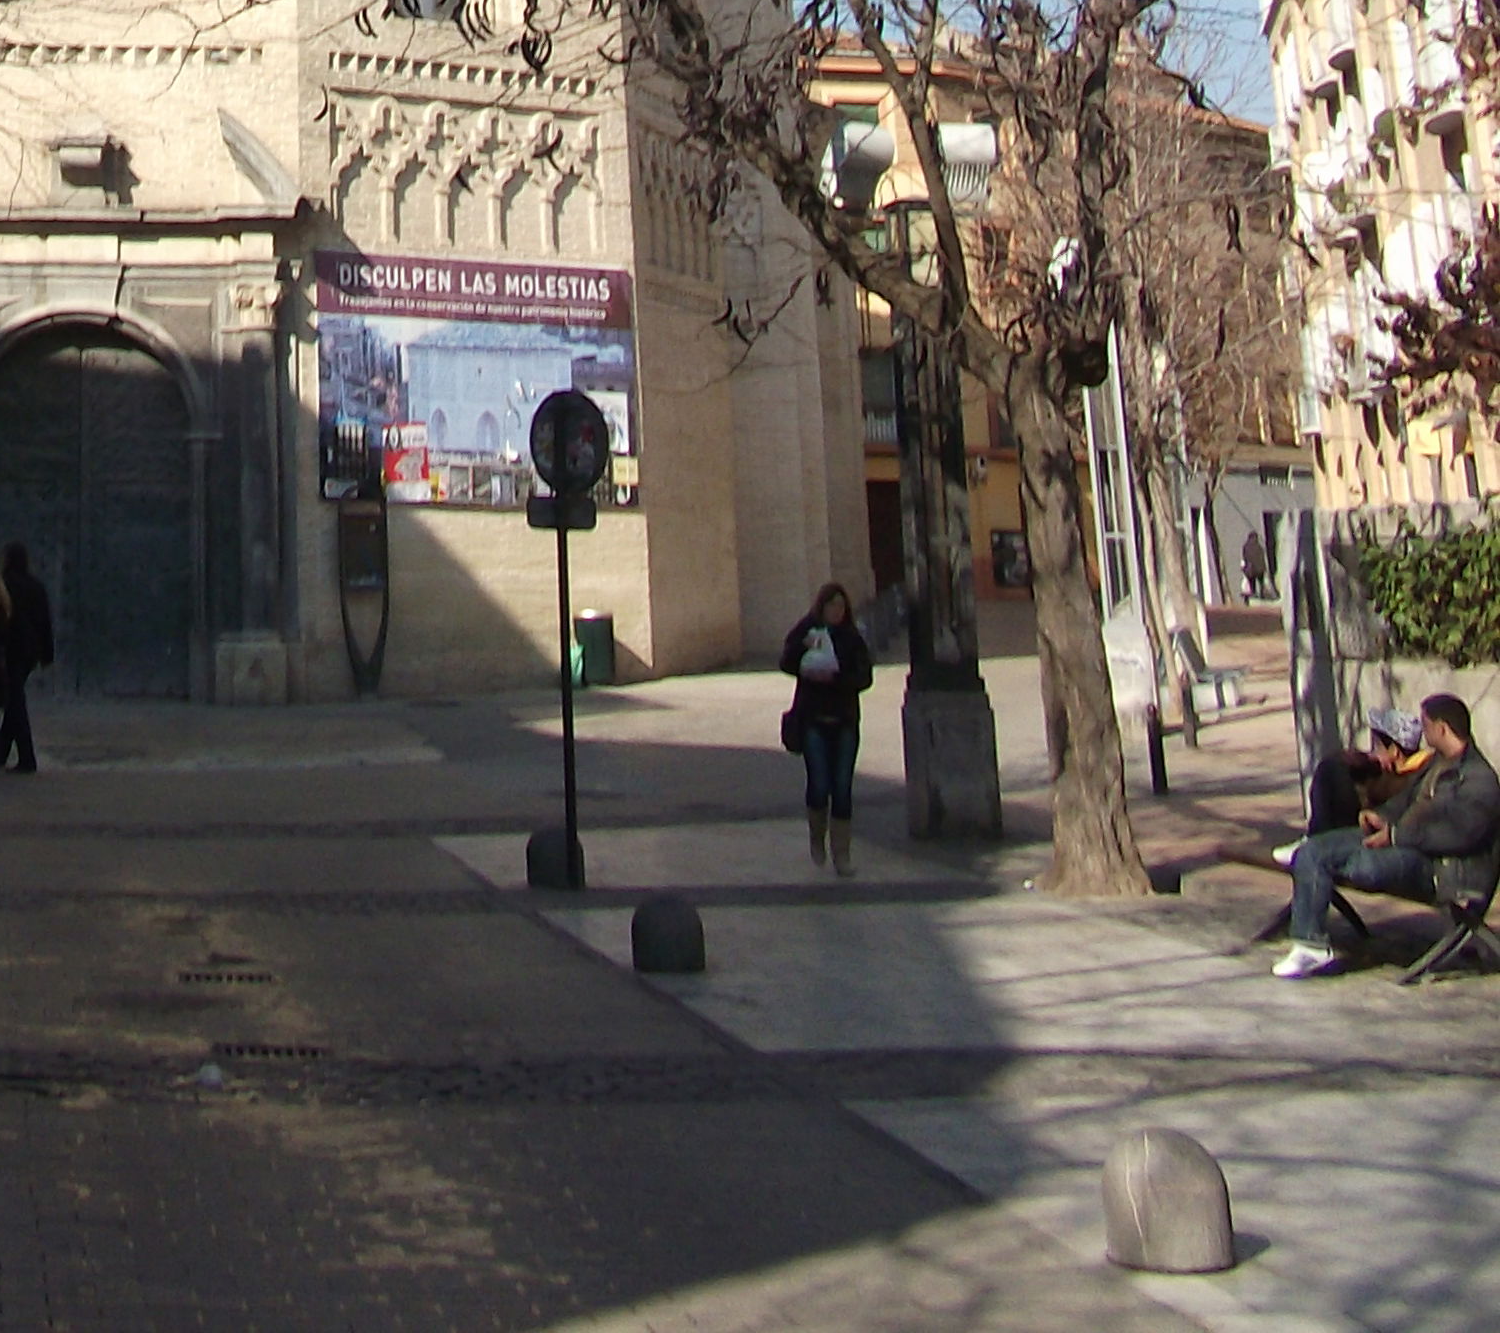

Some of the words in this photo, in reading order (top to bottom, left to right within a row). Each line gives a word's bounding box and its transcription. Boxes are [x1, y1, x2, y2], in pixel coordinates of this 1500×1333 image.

[339, 262, 451, 293] DISCULPEN
[460, 270, 496, 296] LAS
[505, 272, 610, 302] MOLESTIAS
[476, 302, 486, 314] de
